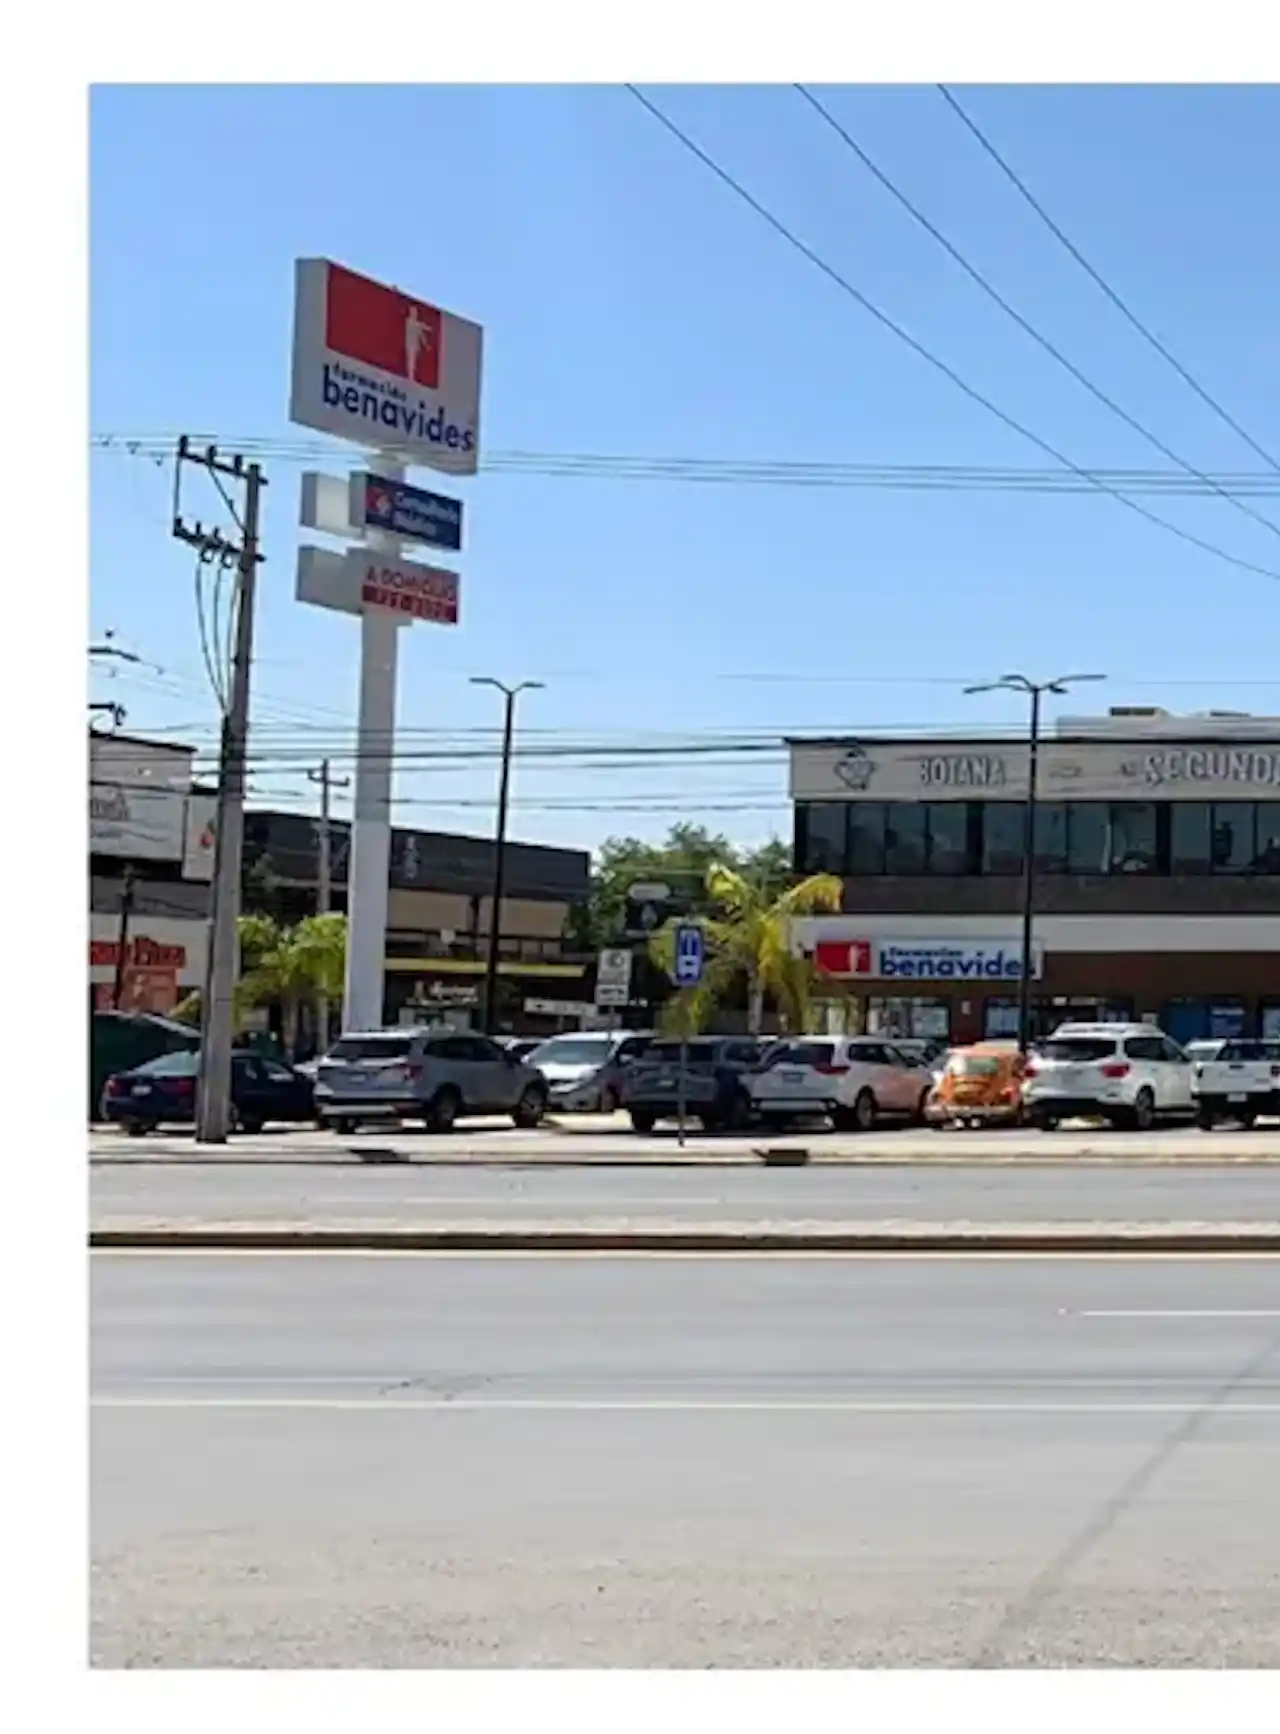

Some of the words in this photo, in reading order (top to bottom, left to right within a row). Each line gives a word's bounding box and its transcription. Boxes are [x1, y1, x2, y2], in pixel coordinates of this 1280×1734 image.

[323, 365, 473, 452] benavides
[920, 756, 1006, 786] BOTANA
[880, 950, 1036, 976] benavide
